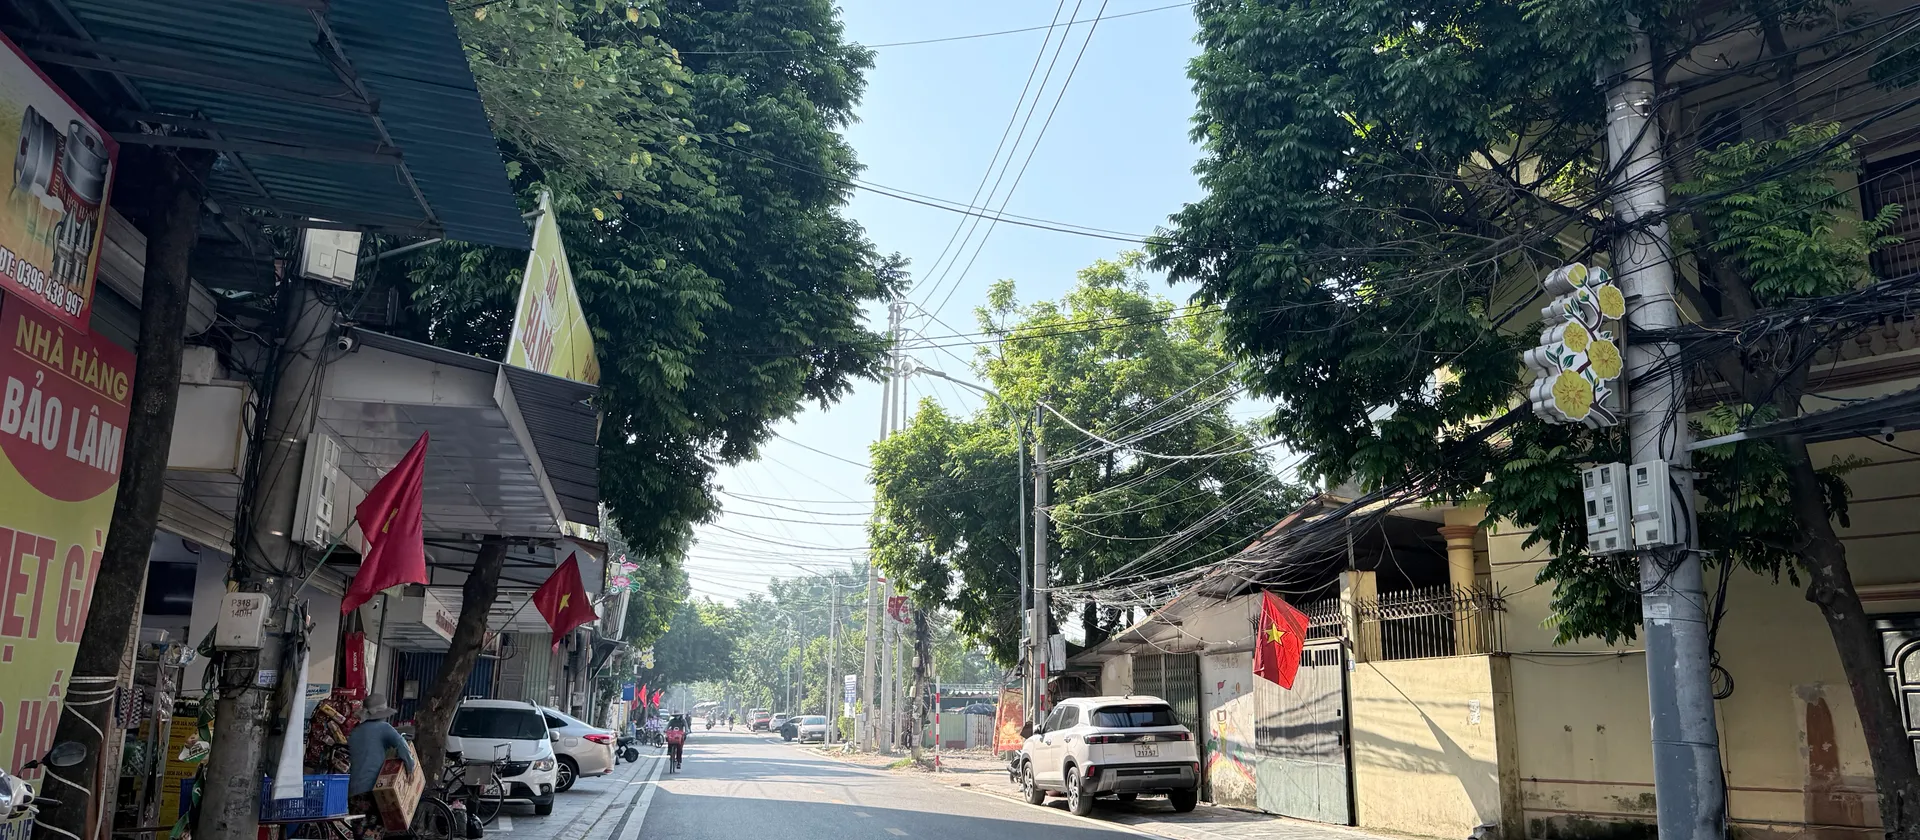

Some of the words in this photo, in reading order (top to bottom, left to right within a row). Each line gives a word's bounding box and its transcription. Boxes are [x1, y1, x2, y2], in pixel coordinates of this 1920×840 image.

[16, 258, 45, 295] 0396
[44, 276, 65, 309] 438
[65, 289, 85, 318] 997
[15, 314, 65, 371] NHÀ
[70, 345, 129, 401] HÀNG
[0, 369, 63, 451] BẢO
[65, 404, 123, 475] LÂM
